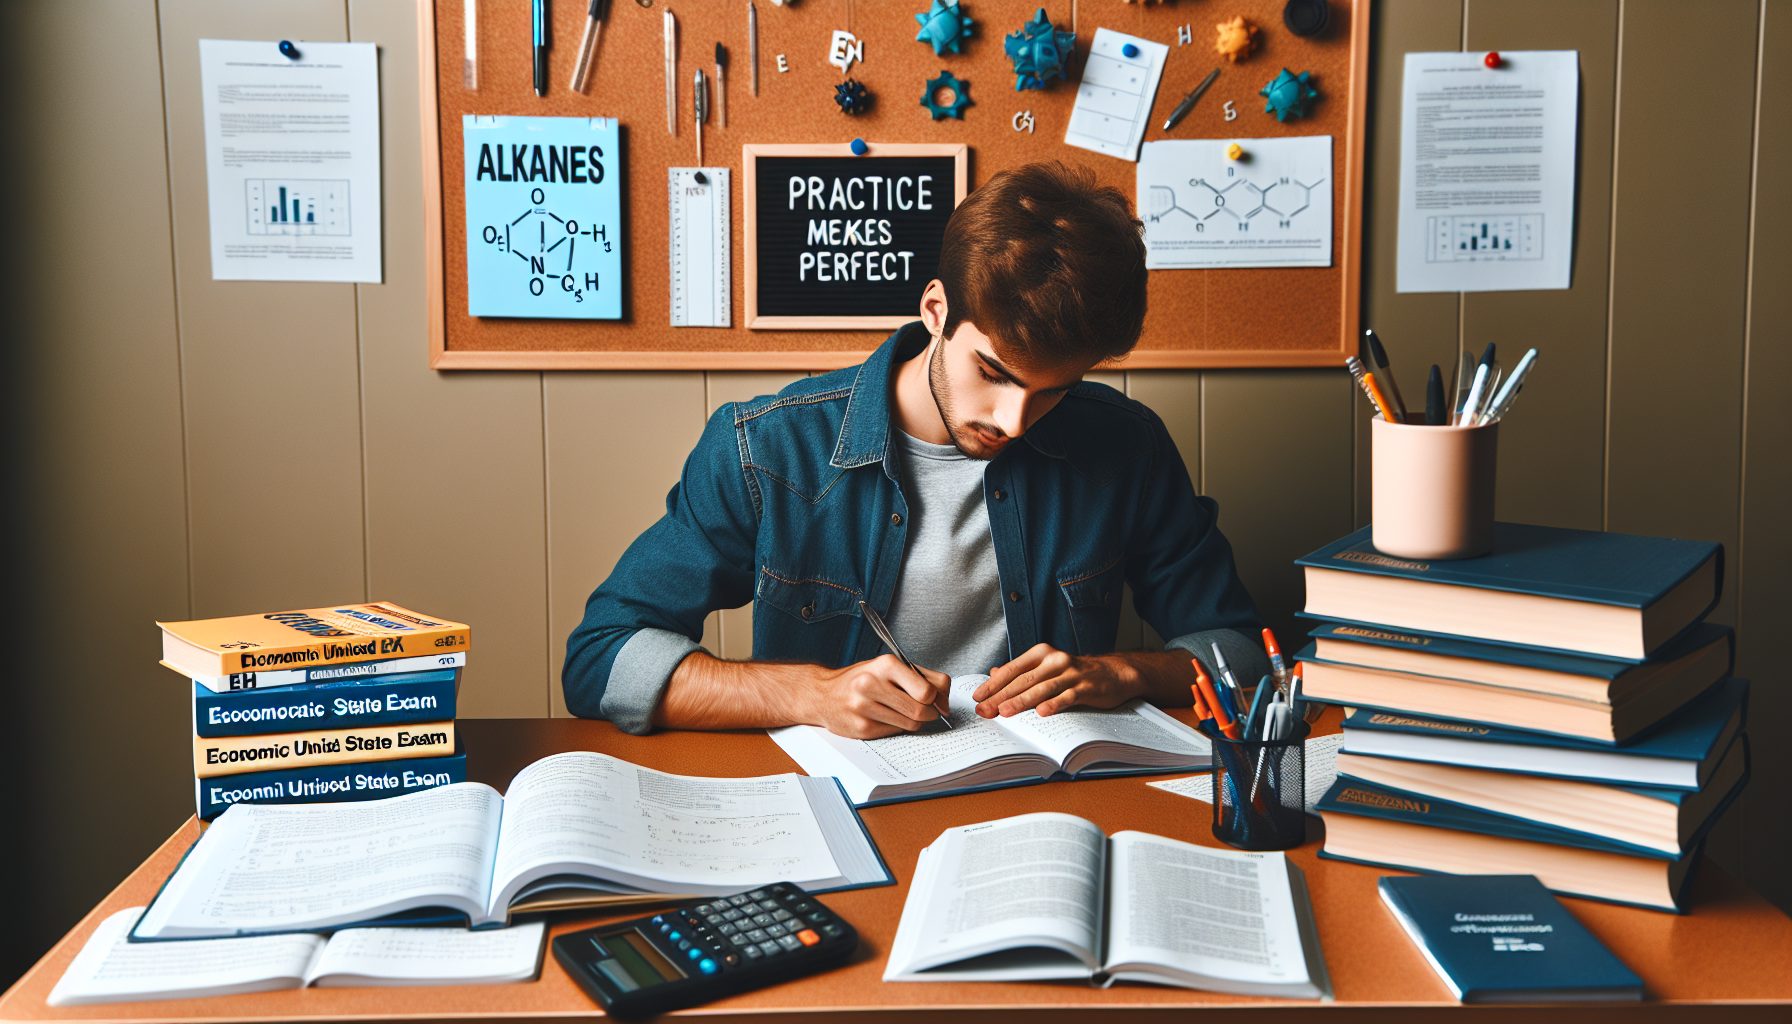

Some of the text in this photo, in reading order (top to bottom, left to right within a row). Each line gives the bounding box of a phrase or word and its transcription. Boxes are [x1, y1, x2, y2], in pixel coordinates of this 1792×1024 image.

[776, 54, 788, 73] E
[476, 143, 605, 185] ALKANES
[788, 175, 933, 211] PRACTICE
[800, 251, 915, 282] PERFECT
[229, 671, 257, 690] EH
